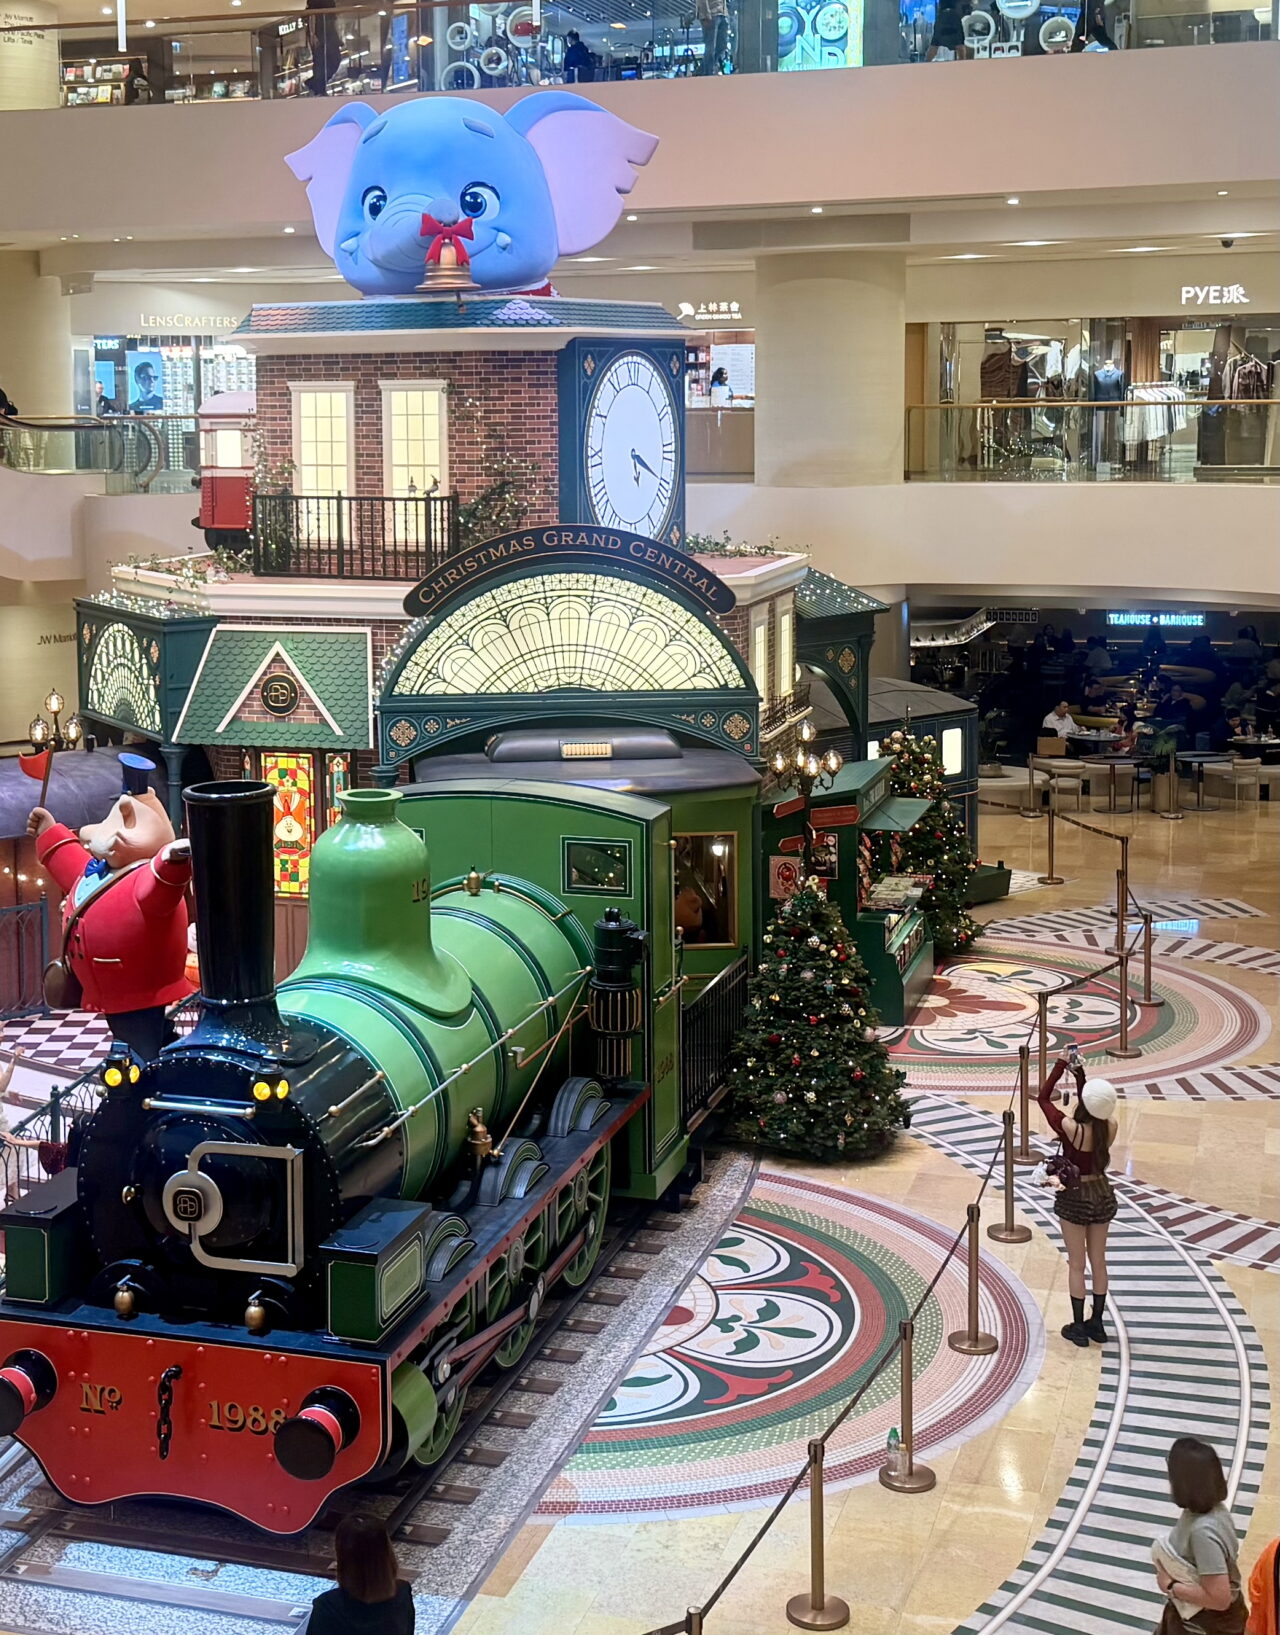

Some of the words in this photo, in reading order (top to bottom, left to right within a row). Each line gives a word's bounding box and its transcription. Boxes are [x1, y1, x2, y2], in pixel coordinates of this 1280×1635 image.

[419, 536, 535, 604] CHRISTMAS
[542, 530, 621, 550] GRAND
[629, 541, 720, 602] CENTRAL
[1108, 613, 1151, 625] TEAHOUSE
[208, 1399, 288, 1436] 1988
